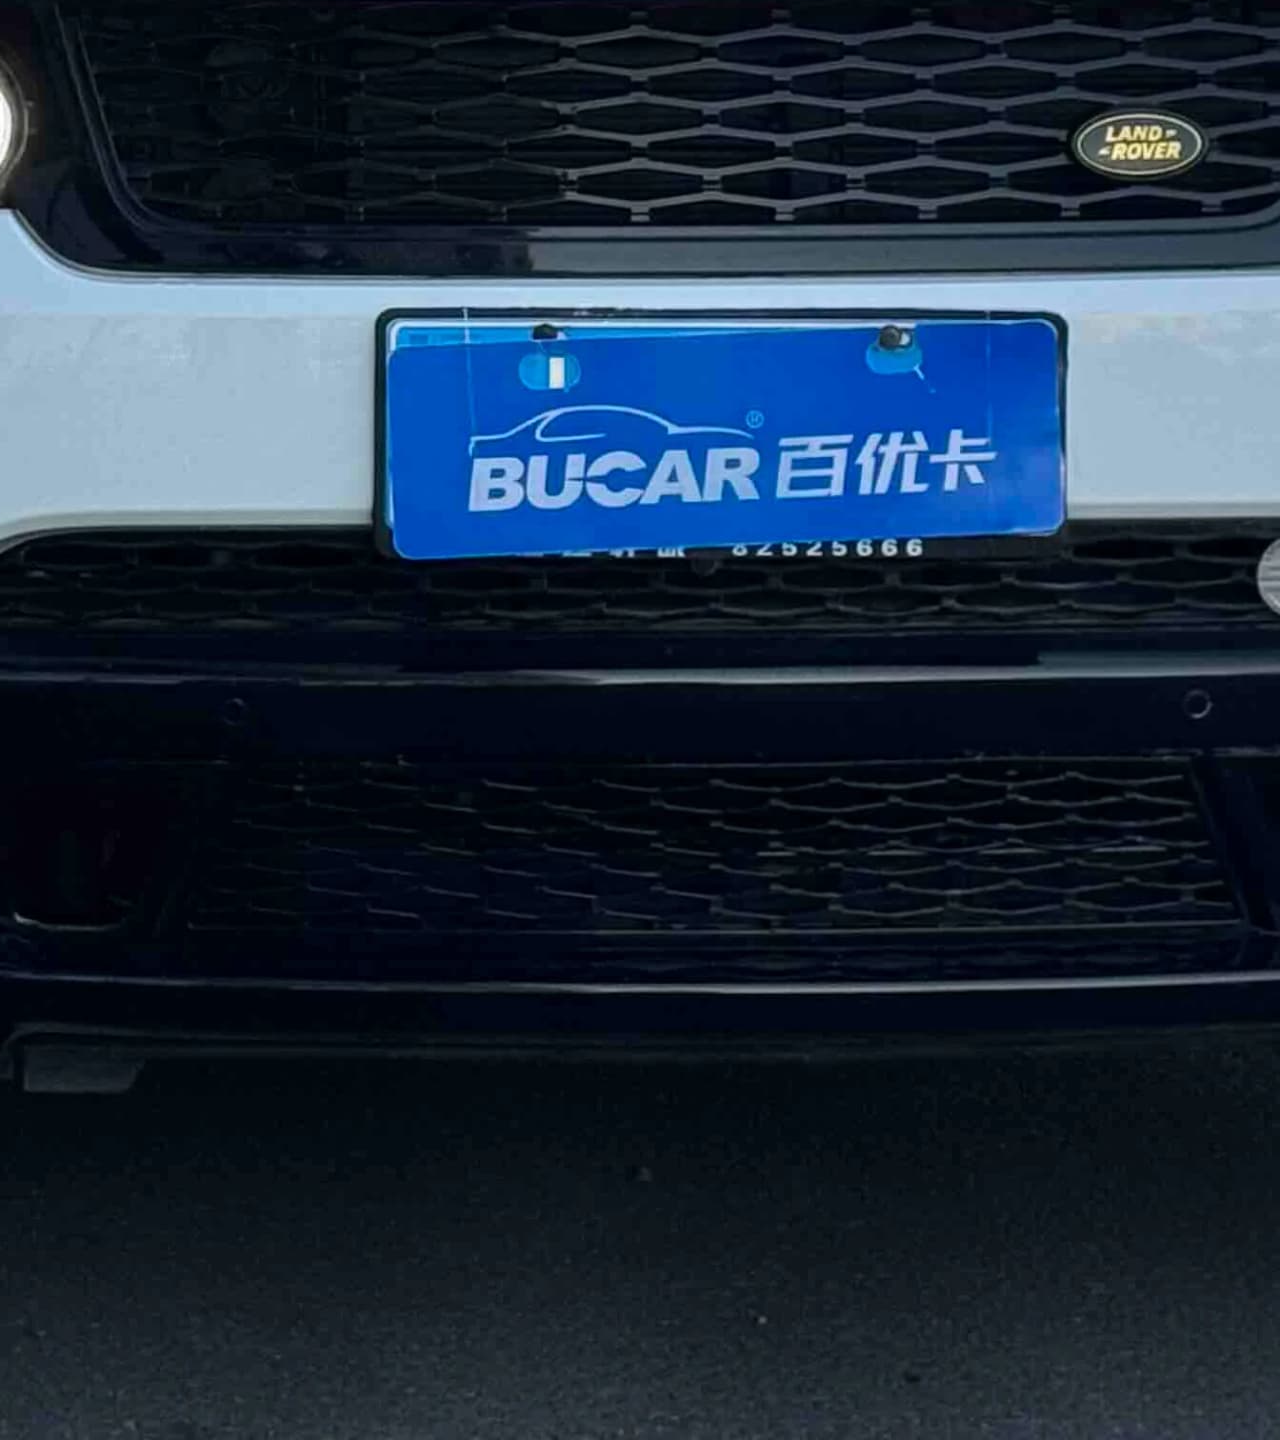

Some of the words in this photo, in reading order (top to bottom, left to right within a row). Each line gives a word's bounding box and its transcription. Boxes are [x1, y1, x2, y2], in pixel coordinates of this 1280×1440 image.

[1105, 125, 1163, 142] LAND
[1111, 141, 1182, 160] ROVER
[468, 447, 761, 512] BUCAR
[776, 429, 998, 498] 百优卡
